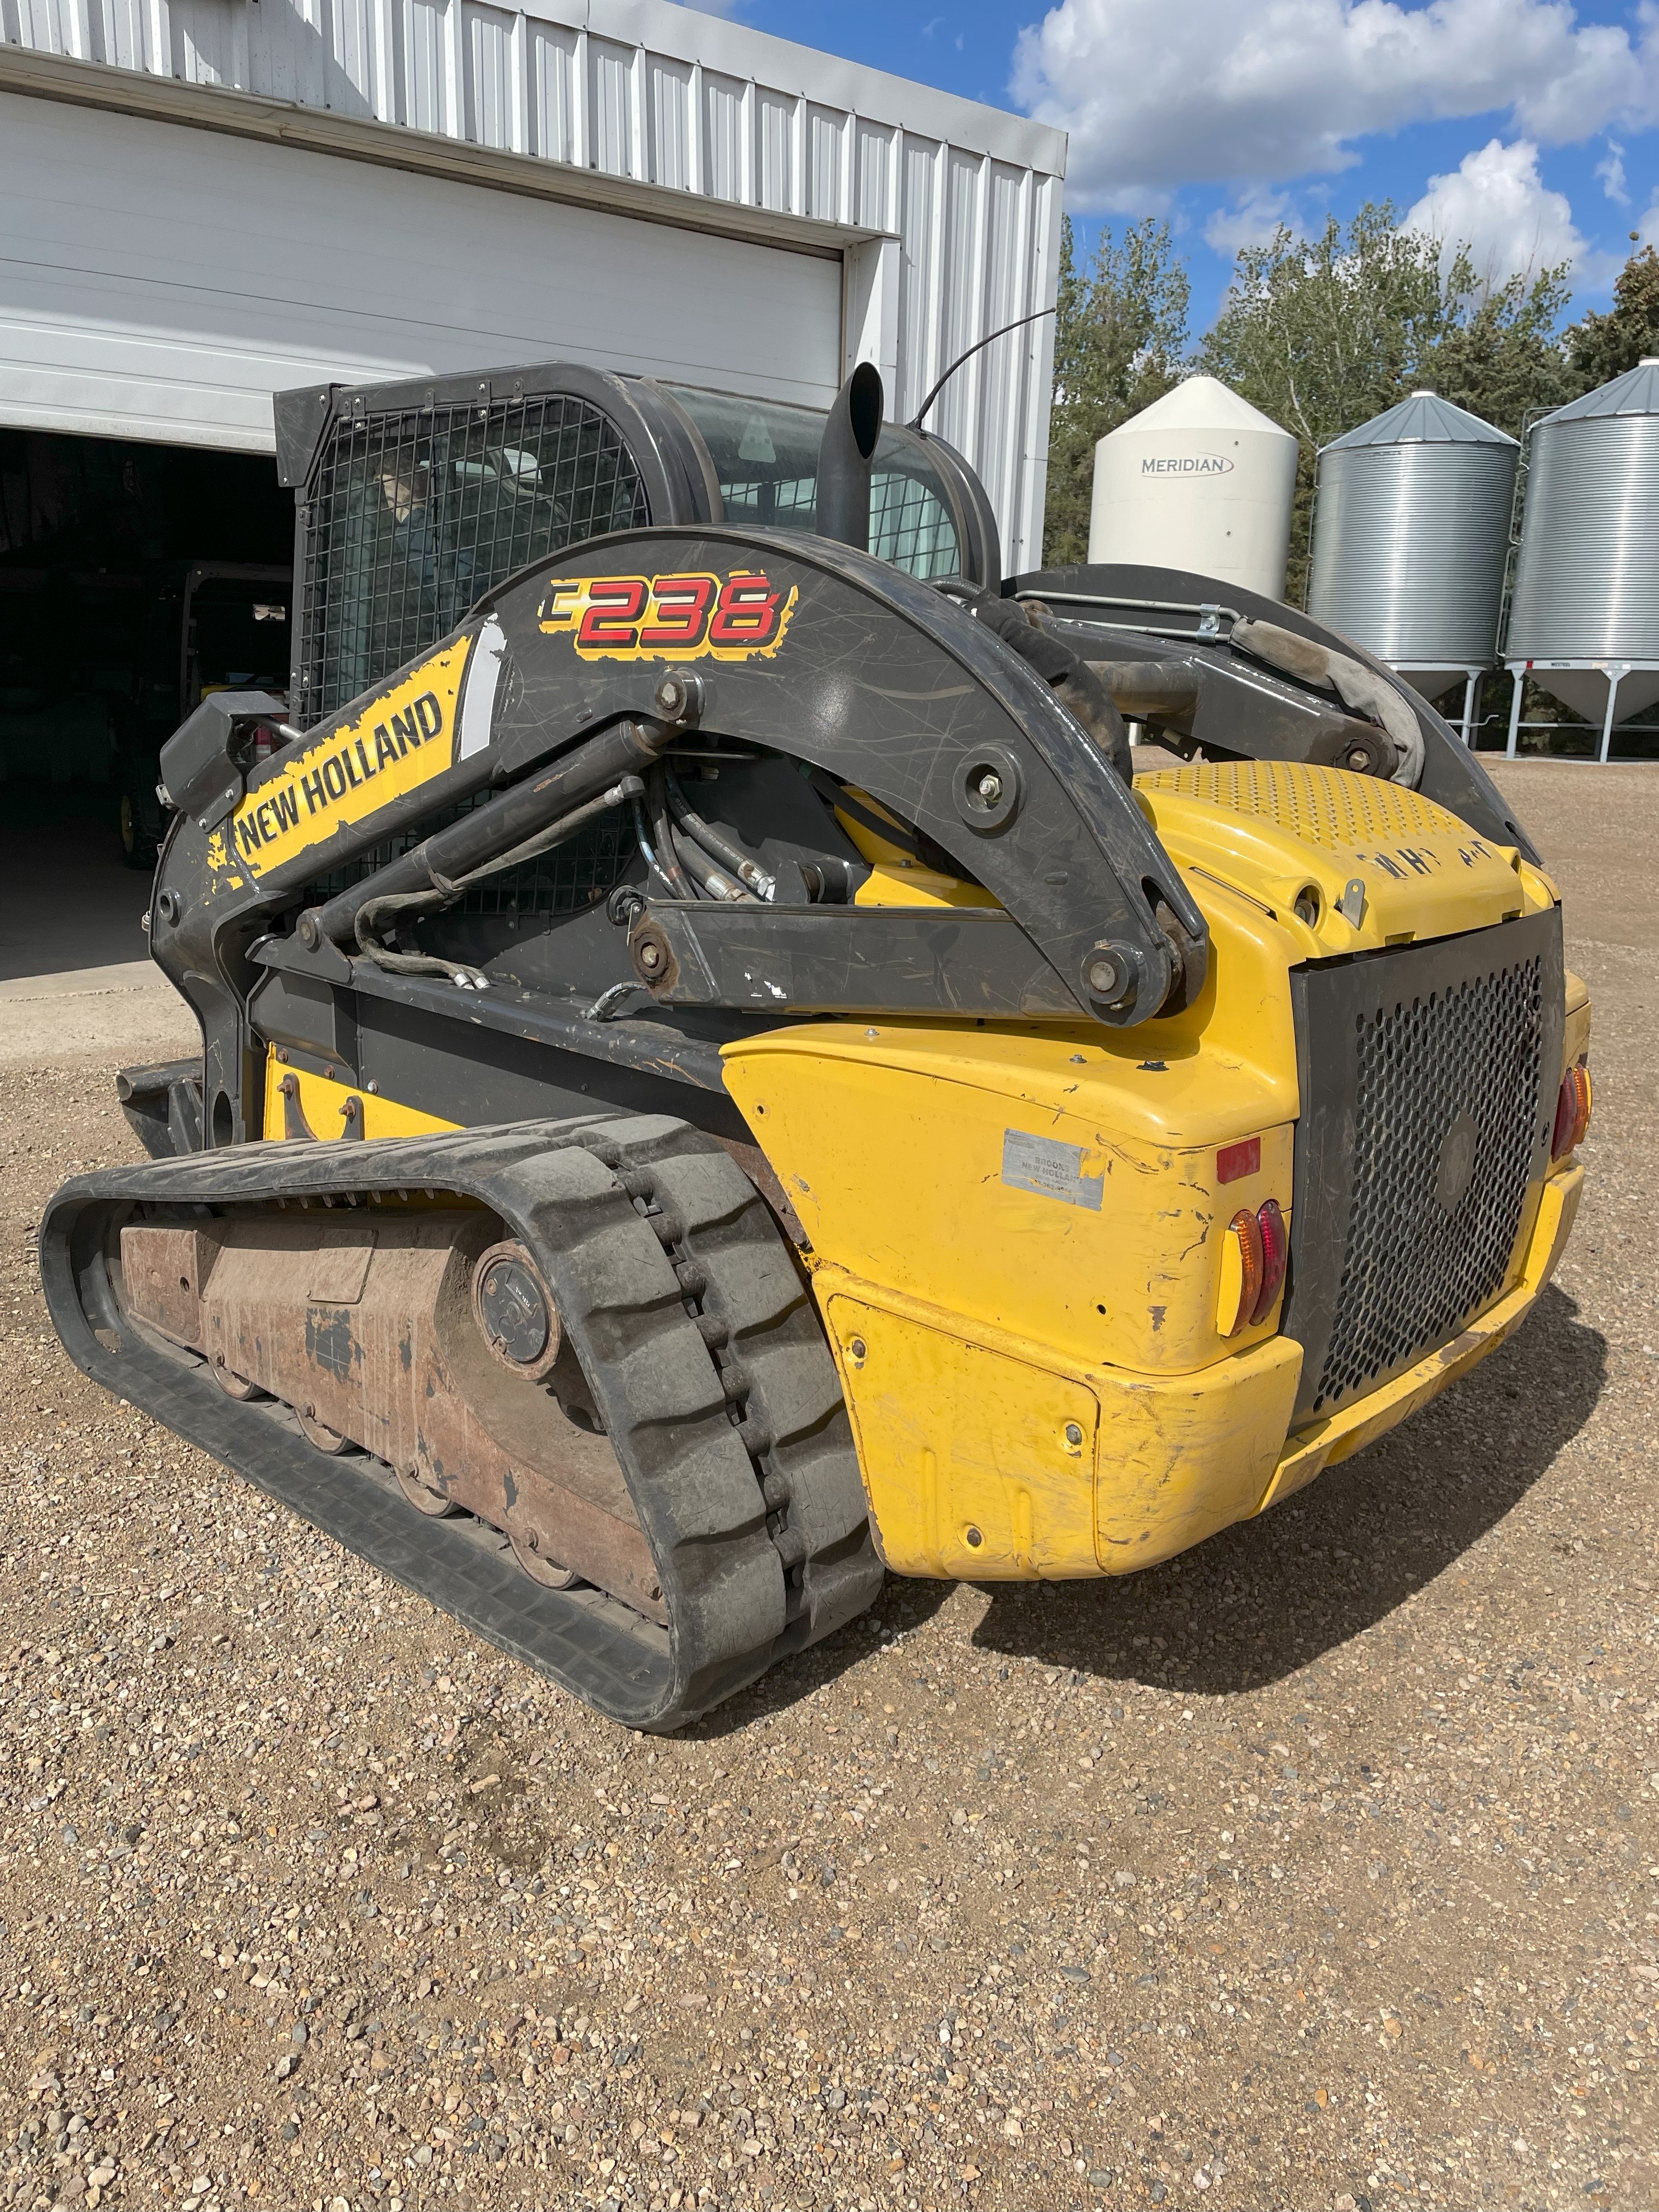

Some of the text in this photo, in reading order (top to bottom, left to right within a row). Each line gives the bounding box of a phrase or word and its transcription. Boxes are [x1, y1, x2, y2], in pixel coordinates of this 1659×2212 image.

[1142, 459, 1224, 473] MERIDIAN
[237, 691, 443, 856] NEW HOLLAND
[1022, 1161, 1040, 1172] NEW
[1035, 1157, 1070, 1172] BROOKS
